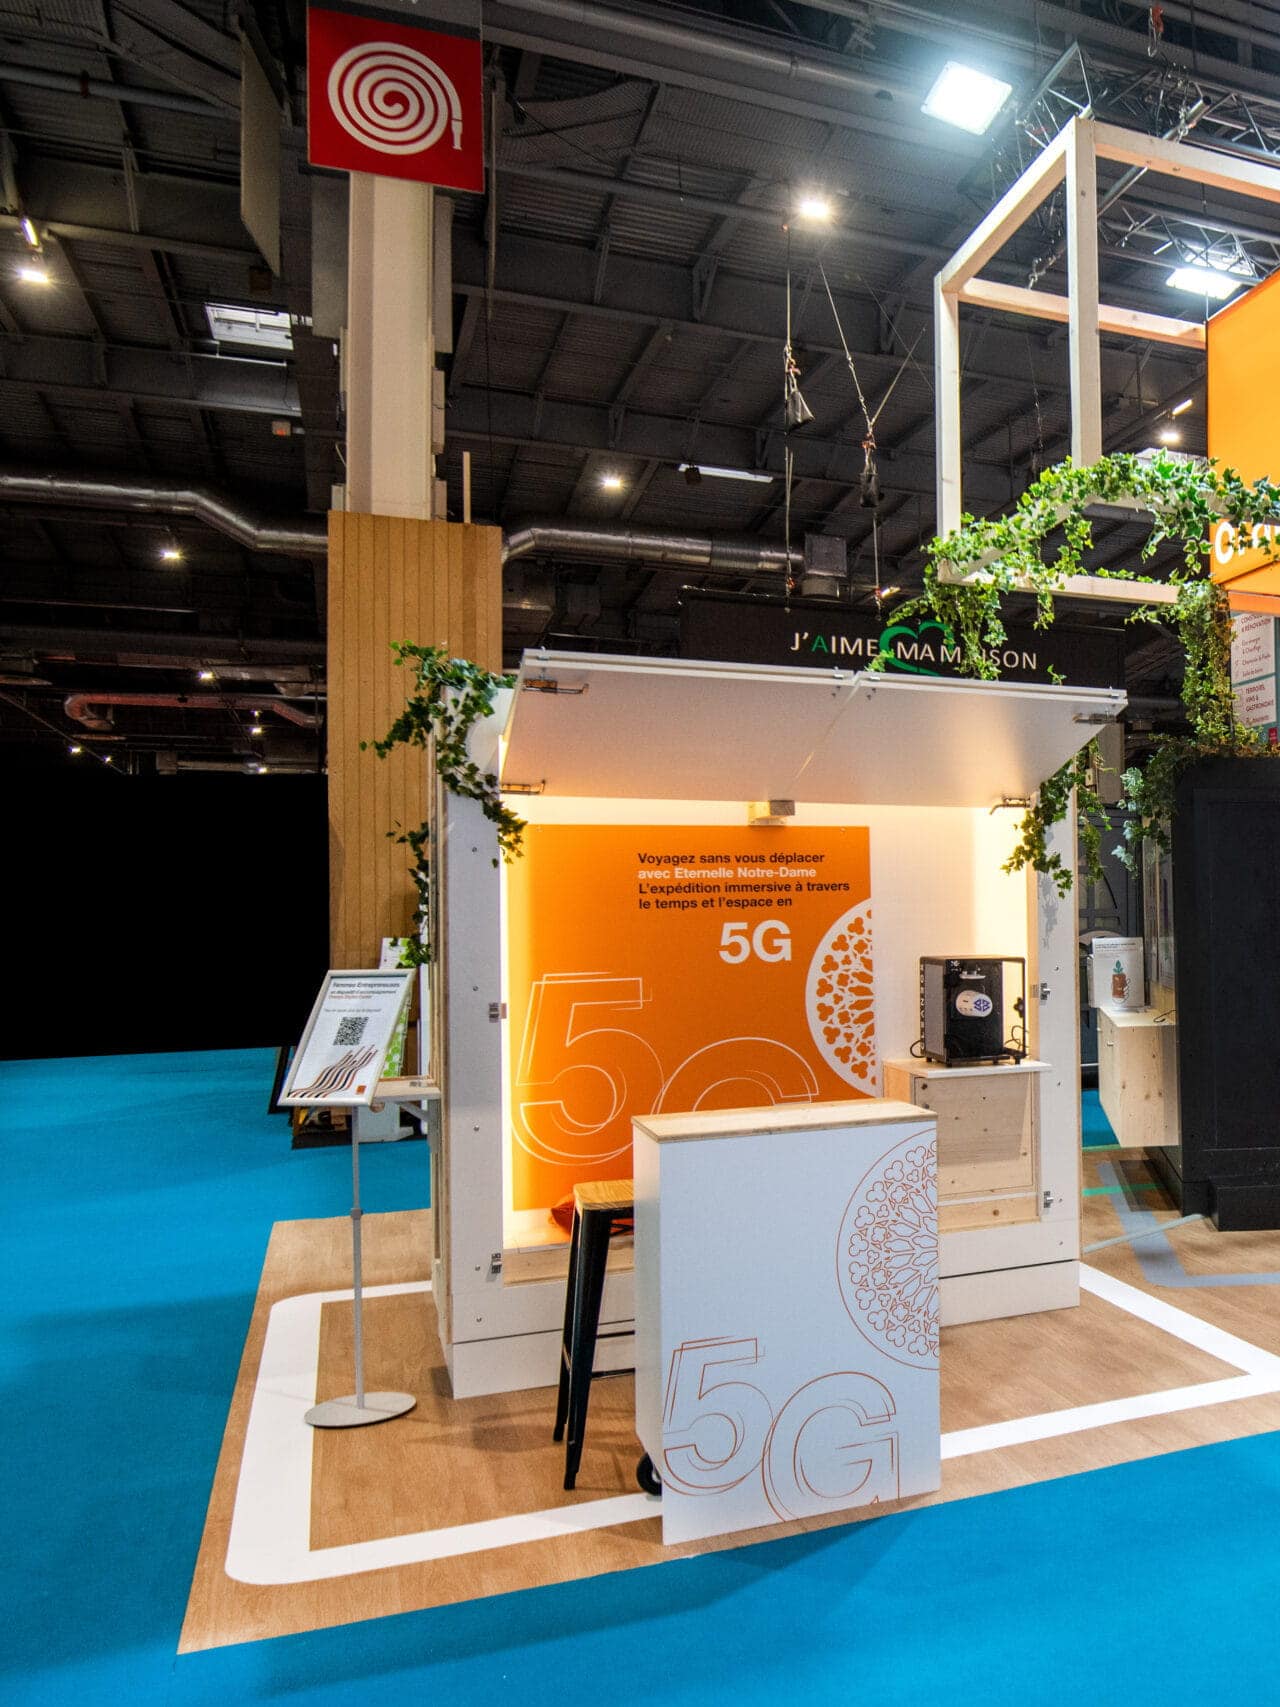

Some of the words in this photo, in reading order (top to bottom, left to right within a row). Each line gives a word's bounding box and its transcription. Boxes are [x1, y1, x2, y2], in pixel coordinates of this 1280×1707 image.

[896, 641, 935, 661] MA
[940, 645, 1037, 670] MISON
[638, 853, 695, 866] Voyagez
[699, 854, 731, 863] sans
[735, 853, 765, 863] vous
[769, 852, 824, 865] déplacer
[638, 869, 670, 879] avec
[675, 867, 733, 878] Eternelle
[738, 867, 816, 878] Notre-Dame
[638, 882, 721, 896] L'expédition
[725, 882, 791, 893] immersive
[795, 881, 802, 891] à
[807, 881, 850, 891] travers
[639, 899, 651, 909] le
[655, 899, 697, 911] temps
[701, 898, 714, 908] et
[718, 897, 773, 909] l'espace
[777, 897, 792, 906] en
[718, 920, 792, 965] 5G
[661, 1335, 900, 1523] 5G
